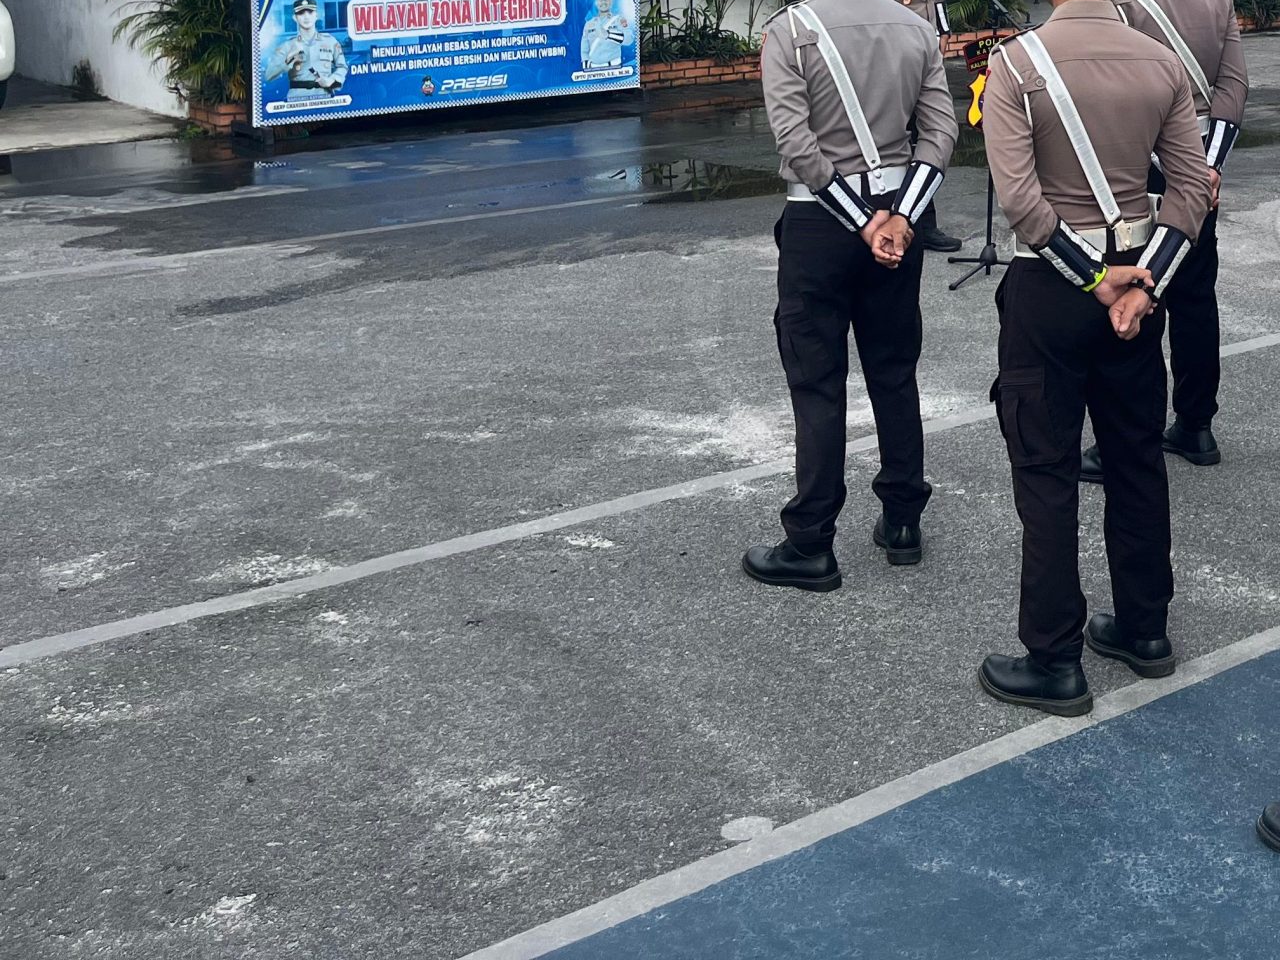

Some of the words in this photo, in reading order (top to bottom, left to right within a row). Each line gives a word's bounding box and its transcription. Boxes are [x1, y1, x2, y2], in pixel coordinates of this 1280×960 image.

[354, 1, 428, 32] WILAYAH
[431, 0, 472, 26] ZONA
[372, 46, 405, 58] MENUJU
[407, 43, 443, 55] WILAYAH
[444, 41, 470, 52] BEBAS
[471, 38, 489, 49] DARI
[491, 36, 524, 47] KORUPSI
[525, 34, 547, 46] (WBK)
[351, 64, 369, 75] DAN
[370, 60, 407, 73] WILAYAH
[408, 57, 451, 70] BIROKRASI
[454, 53, 482, 65] BERSIH
[484, 51, 501, 63] DAN
[501, 48, 538, 61] MELAYANI
[538, 46, 566, 59] (WBBM)
[441, 73, 508, 91] PRESISI
